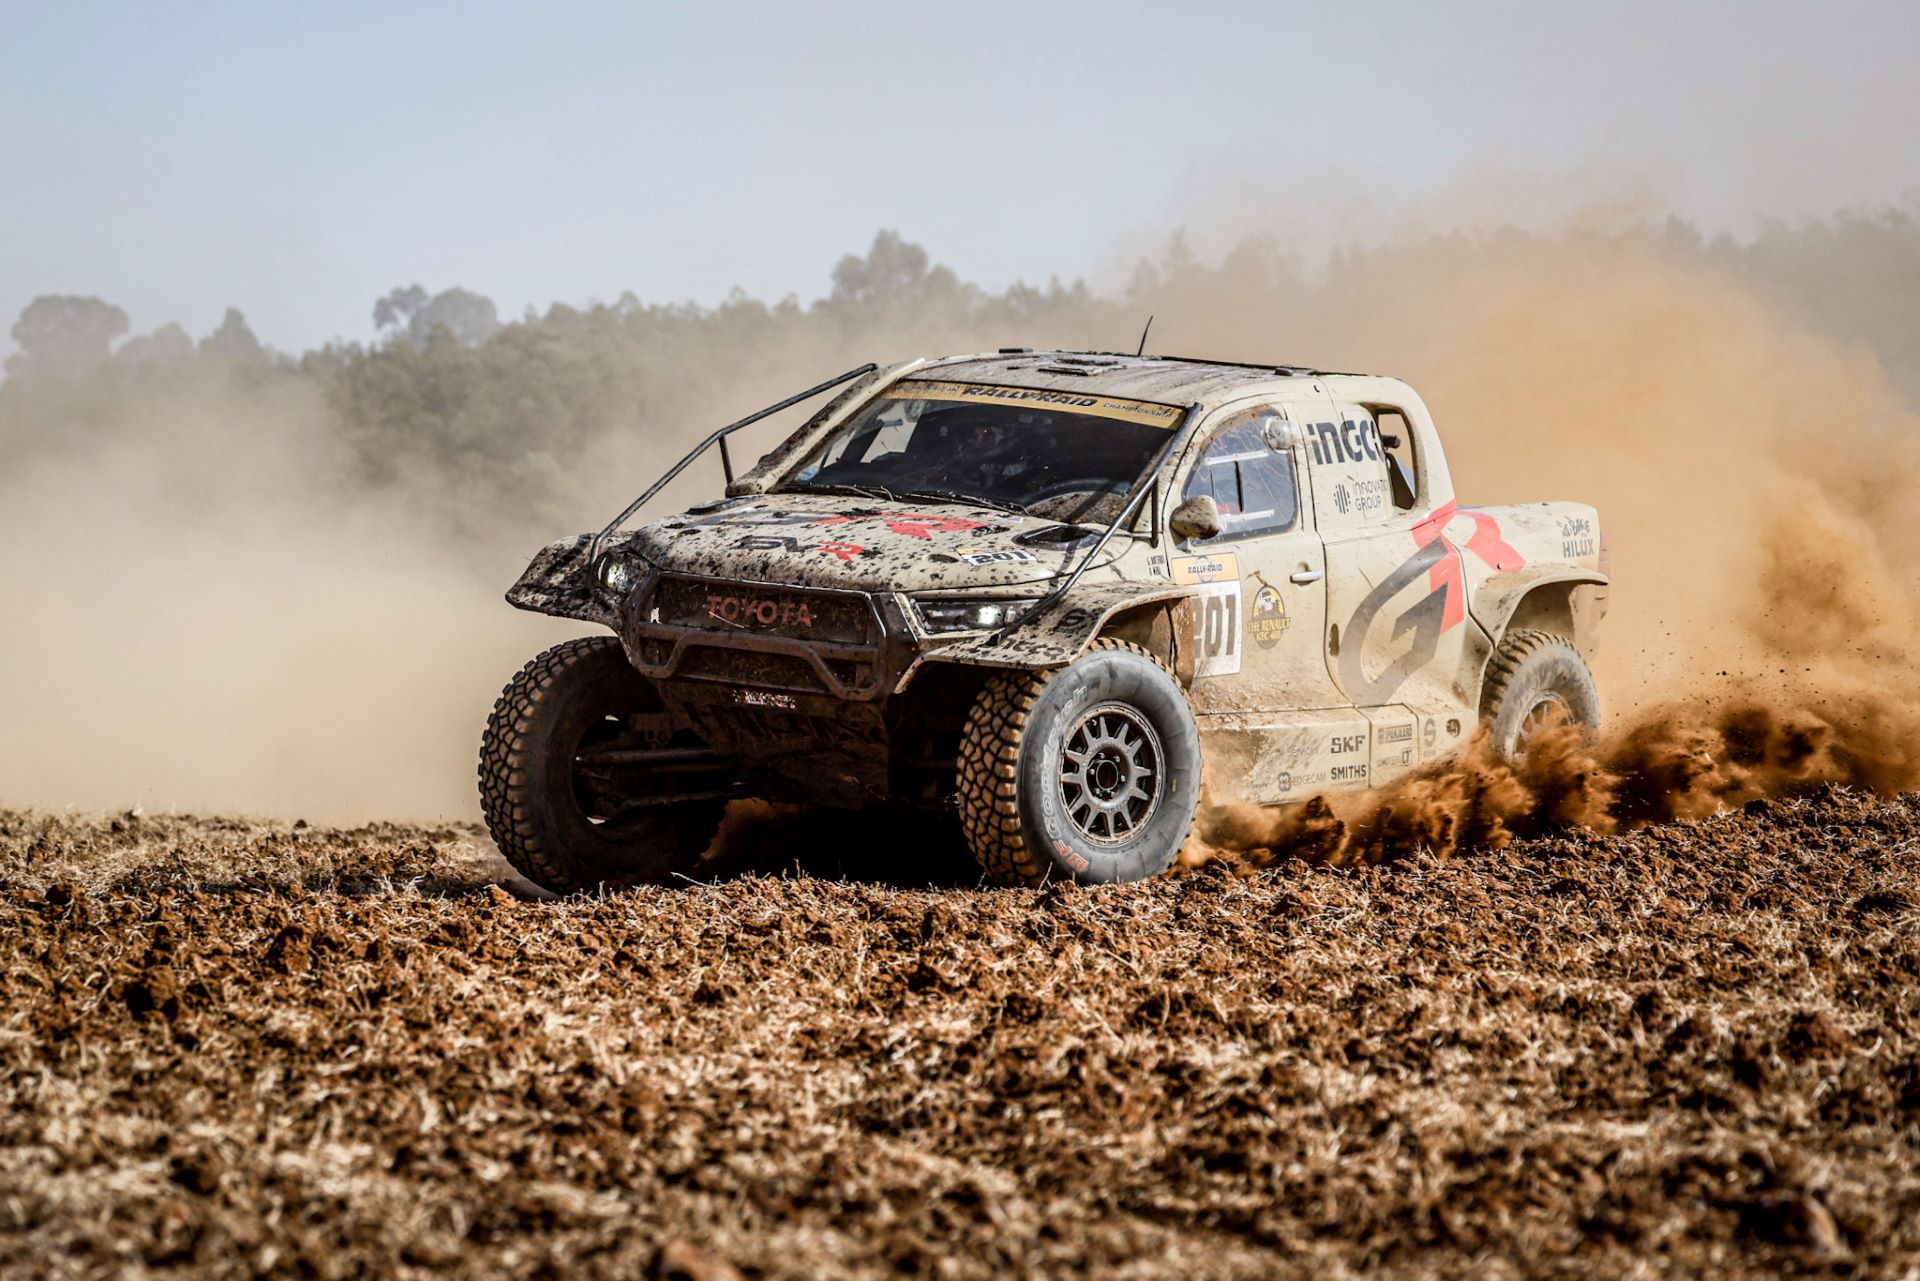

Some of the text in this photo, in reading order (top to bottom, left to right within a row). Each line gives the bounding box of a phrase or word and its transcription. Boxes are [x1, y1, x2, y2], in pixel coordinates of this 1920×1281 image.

[962, 387, 1098, 407] RALLY-RAID
[1102, 402, 1173, 418] CHAMPIONSHIP
[1355, 495, 1381, 511] GROUP
[1562, 539, 1594, 558] HILUX
[972, 551, 1028, 564] 201
[1188, 563, 1222, 574] RALLY-RAID
[706, 596, 811, 627] TOYOTA
[1331, 735, 1365, 753] SKF
[1331, 764, 1366, 780] SMITHS
